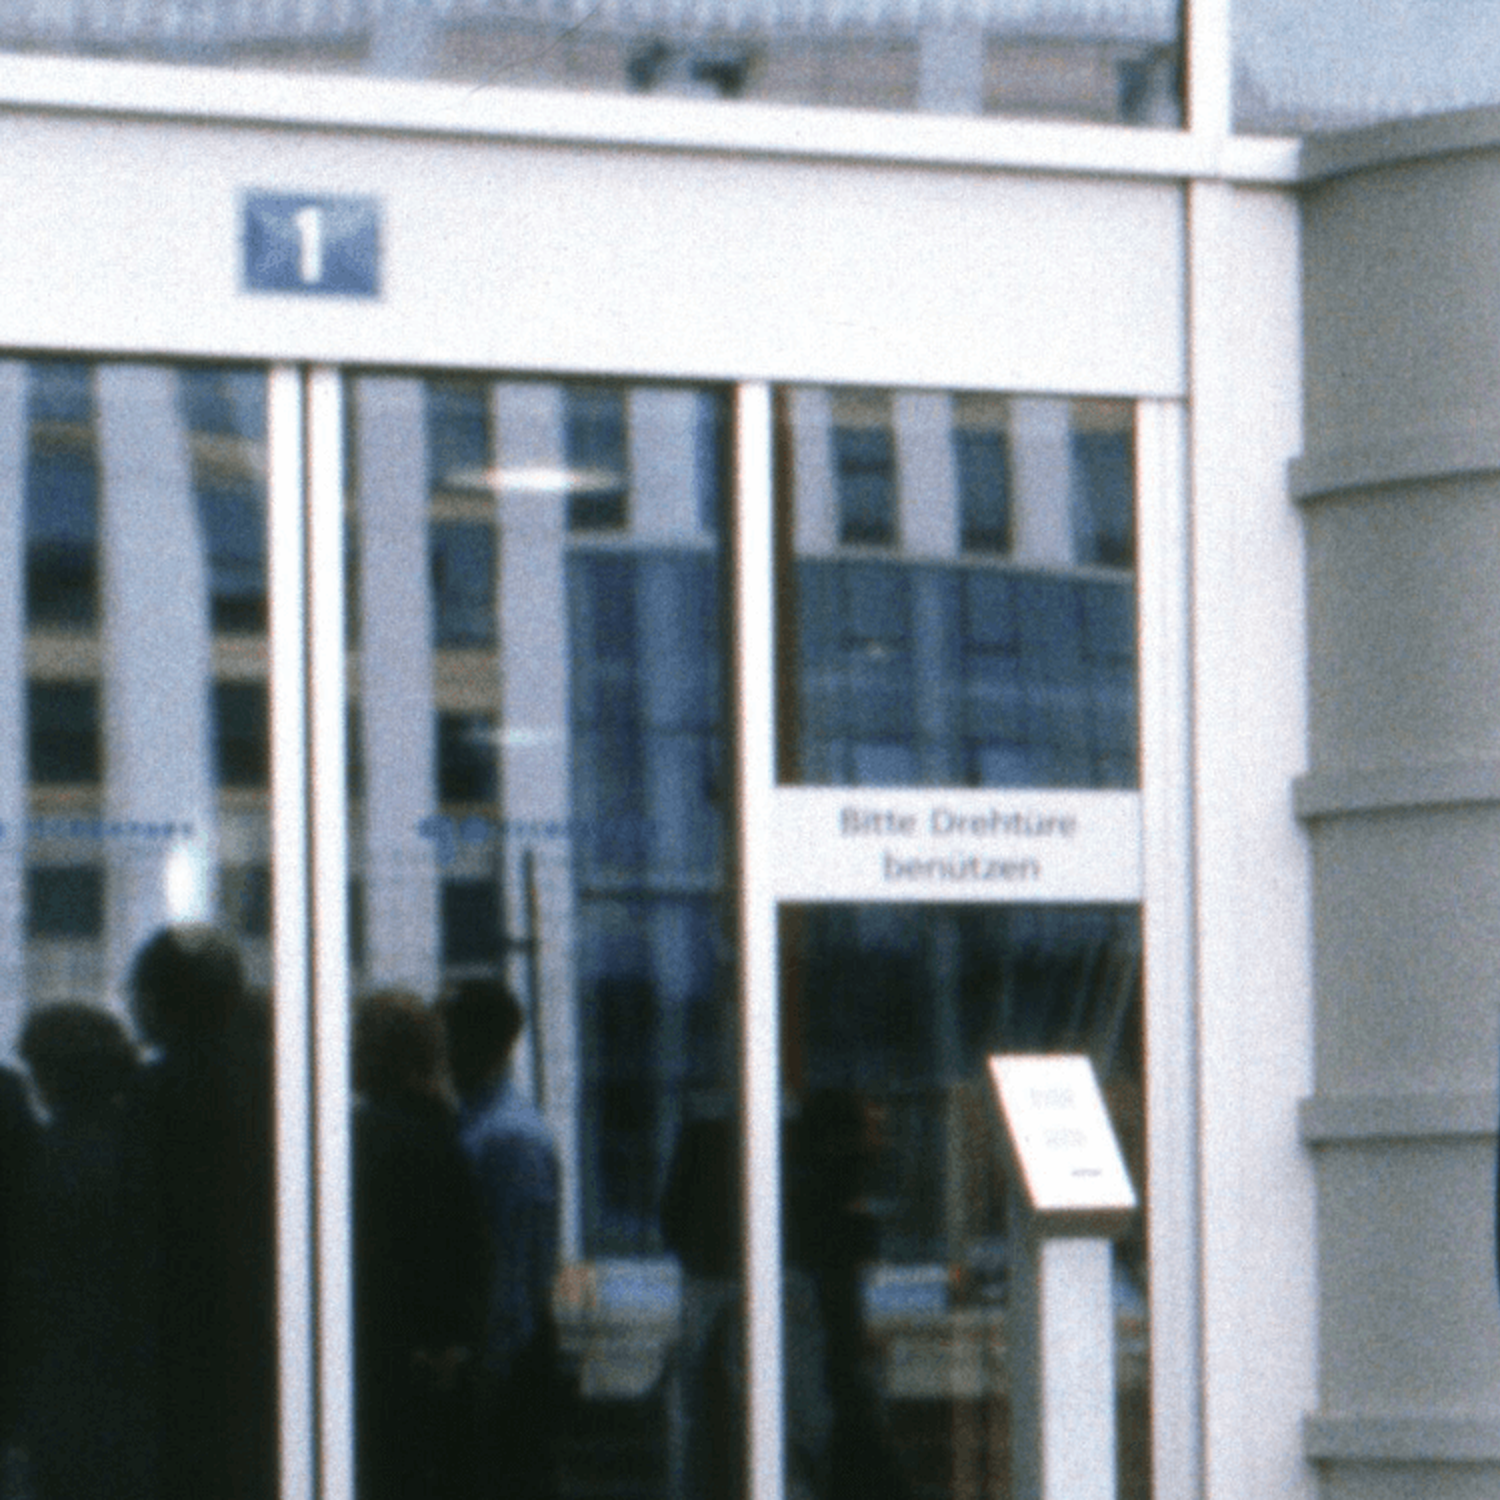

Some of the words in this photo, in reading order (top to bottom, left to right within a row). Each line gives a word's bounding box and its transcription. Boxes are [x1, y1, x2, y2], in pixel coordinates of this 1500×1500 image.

[296, 206, 322, 284] 1
[840, 808, 917, 836] Bitte
[931, 808, 1077, 837] Drehtüre
[882, 851, 1041, 880] benützen
